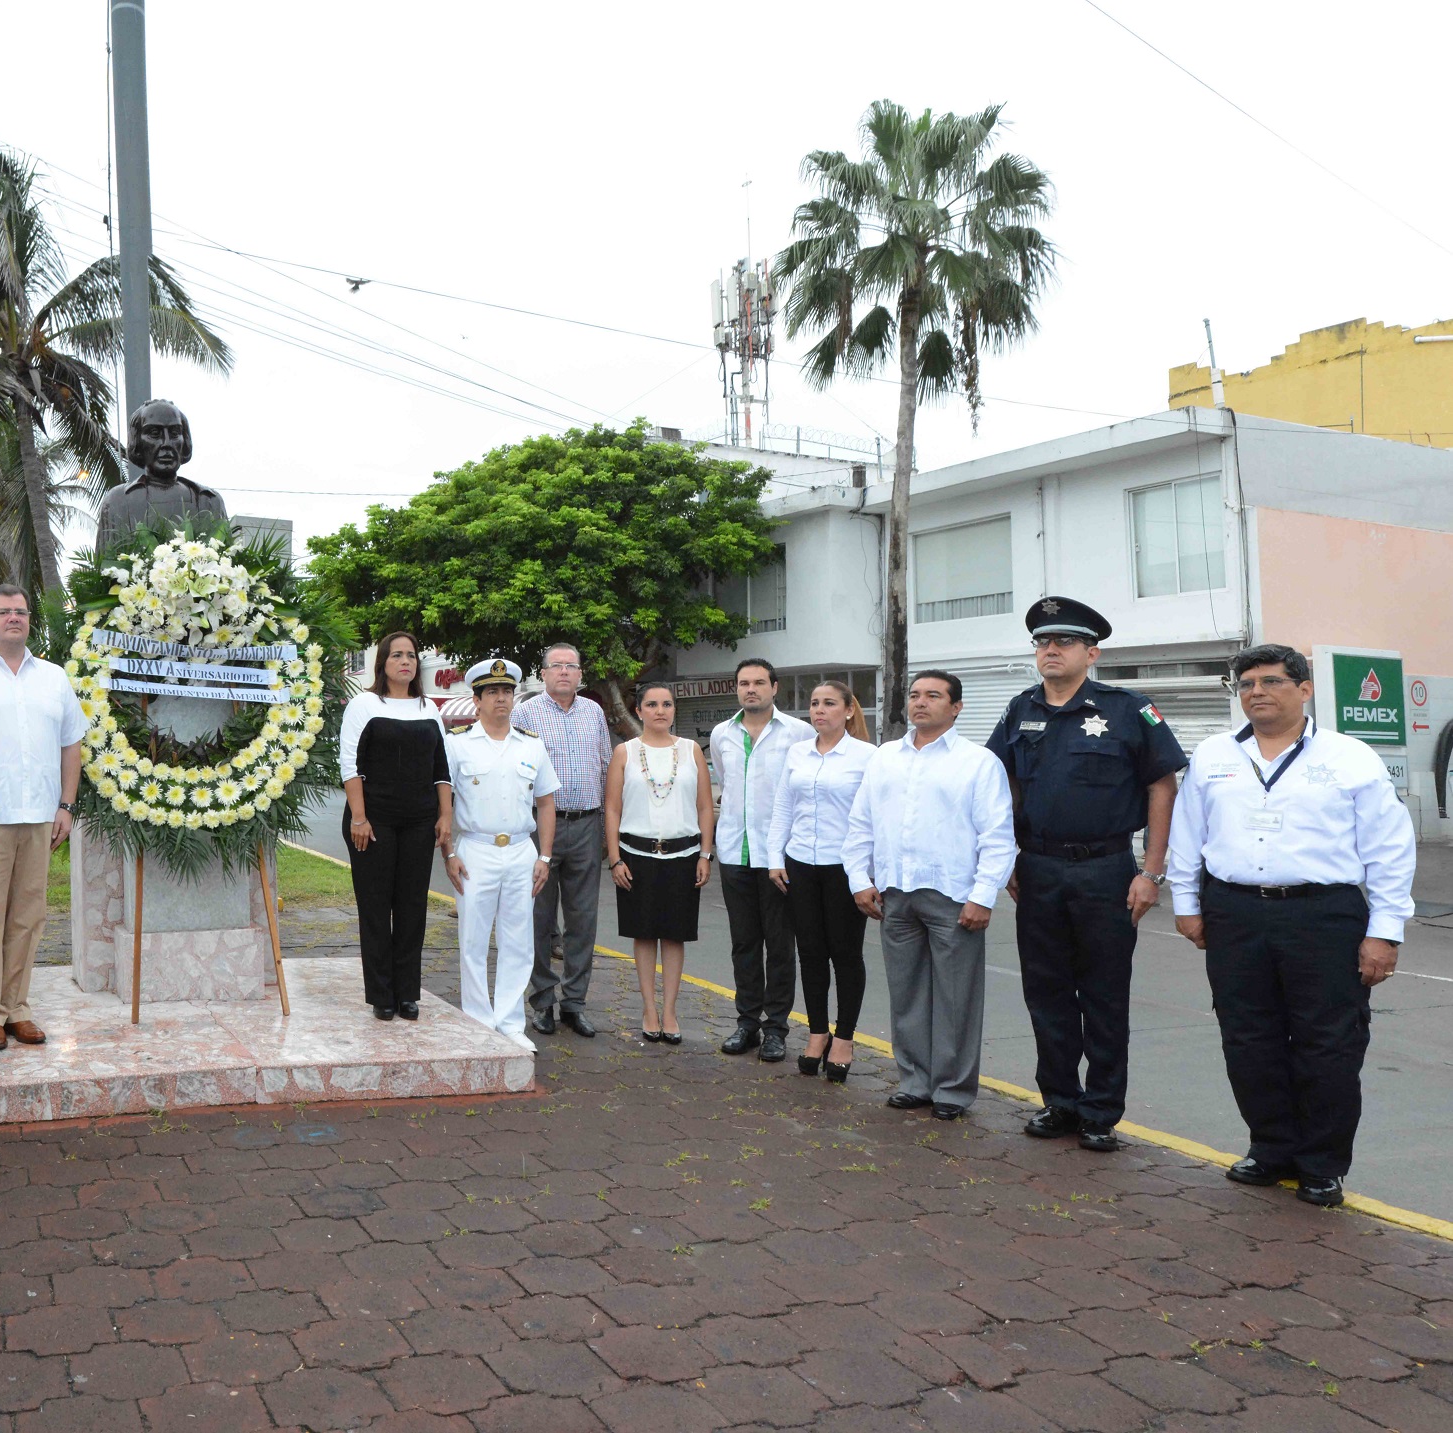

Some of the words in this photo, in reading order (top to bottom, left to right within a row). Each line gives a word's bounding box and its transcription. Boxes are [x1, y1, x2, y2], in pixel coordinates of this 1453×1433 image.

[226, 645, 284, 661] VERACRUZ
[127, 658, 163, 676] DXXV
[242, 673, 263, 683] DEL
[1414, 686, 1424, 698] 10
[1343, 706, 1399, 723] PEMEX
